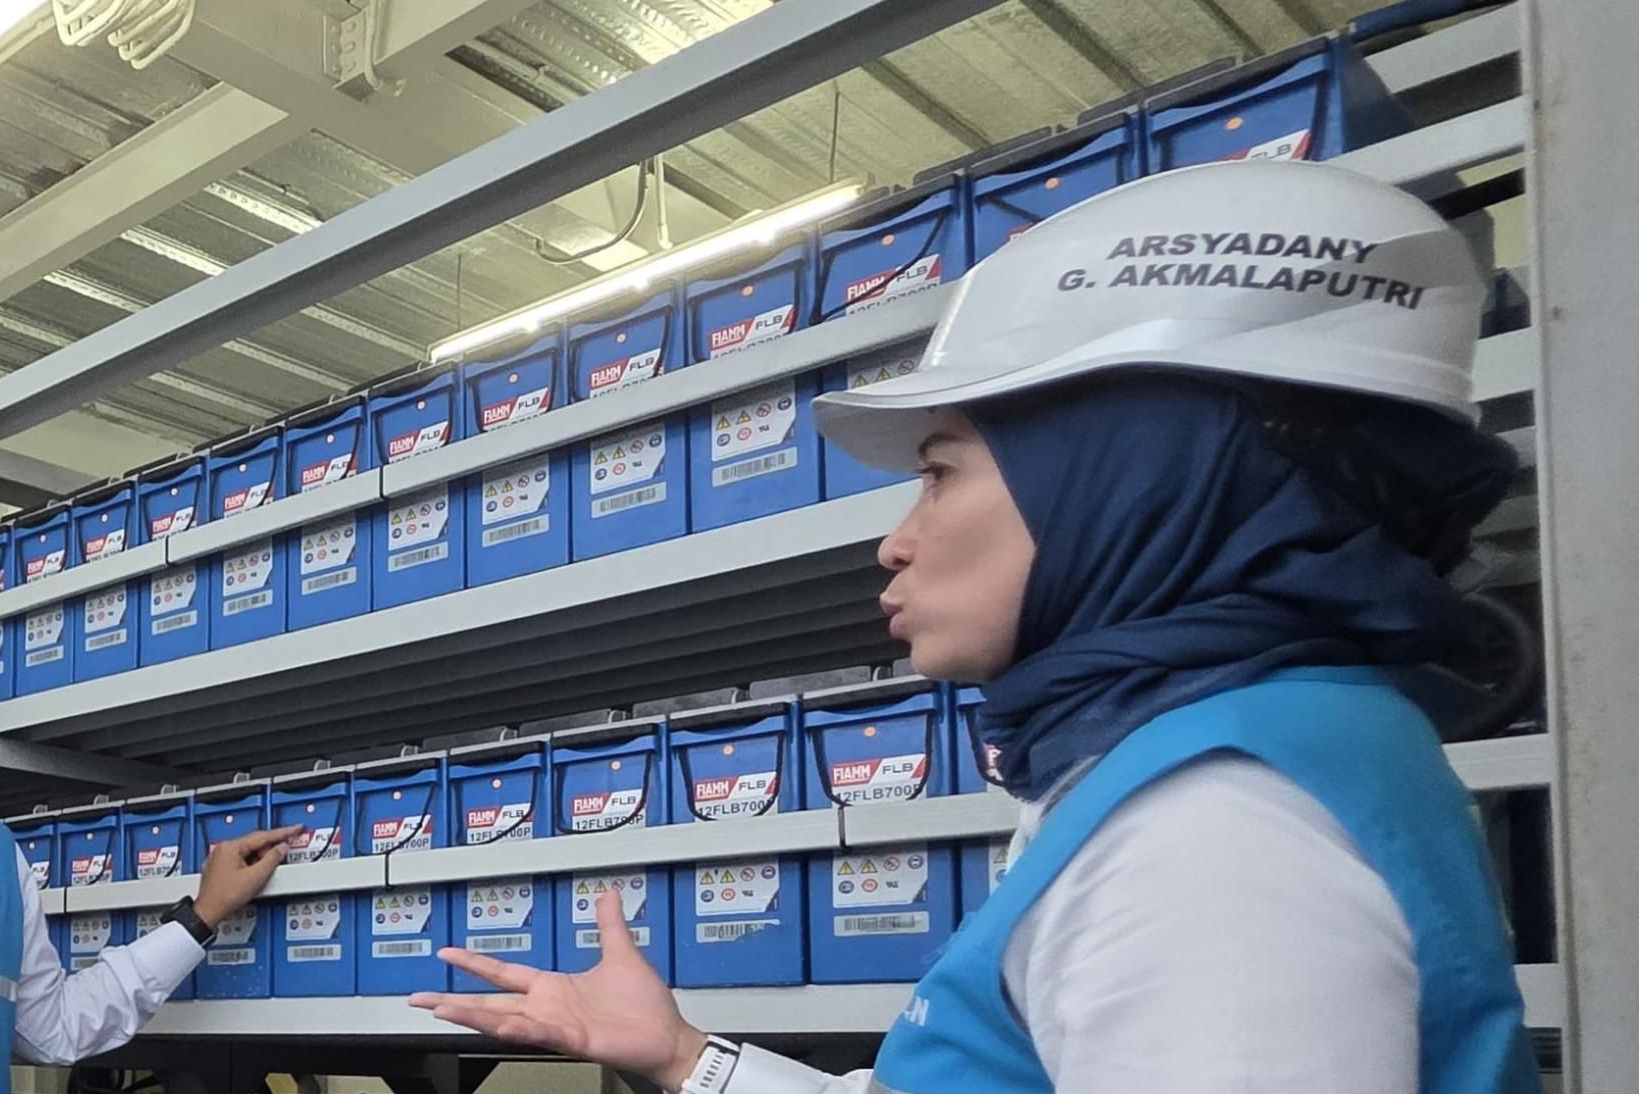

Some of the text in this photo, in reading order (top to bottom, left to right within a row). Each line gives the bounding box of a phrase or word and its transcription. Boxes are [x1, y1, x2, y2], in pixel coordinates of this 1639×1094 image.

[1107, 233, 1379, 263] ARSYADANY
[1058, 264, 1423, 309] G. AKMALAPUTRI
[712, 324, 746, 347] FIAMM
[755, 314, 782, 329] FLB
[629, 356, 654, 370] FLB
[833, 761, 913, 785] FIAMM FLB
[696, 779, 766, 799] FIAMM FLB
[573, 794, 636, 813] FIAMM FLB
[698, 799, 773, 817] 12FLB700
